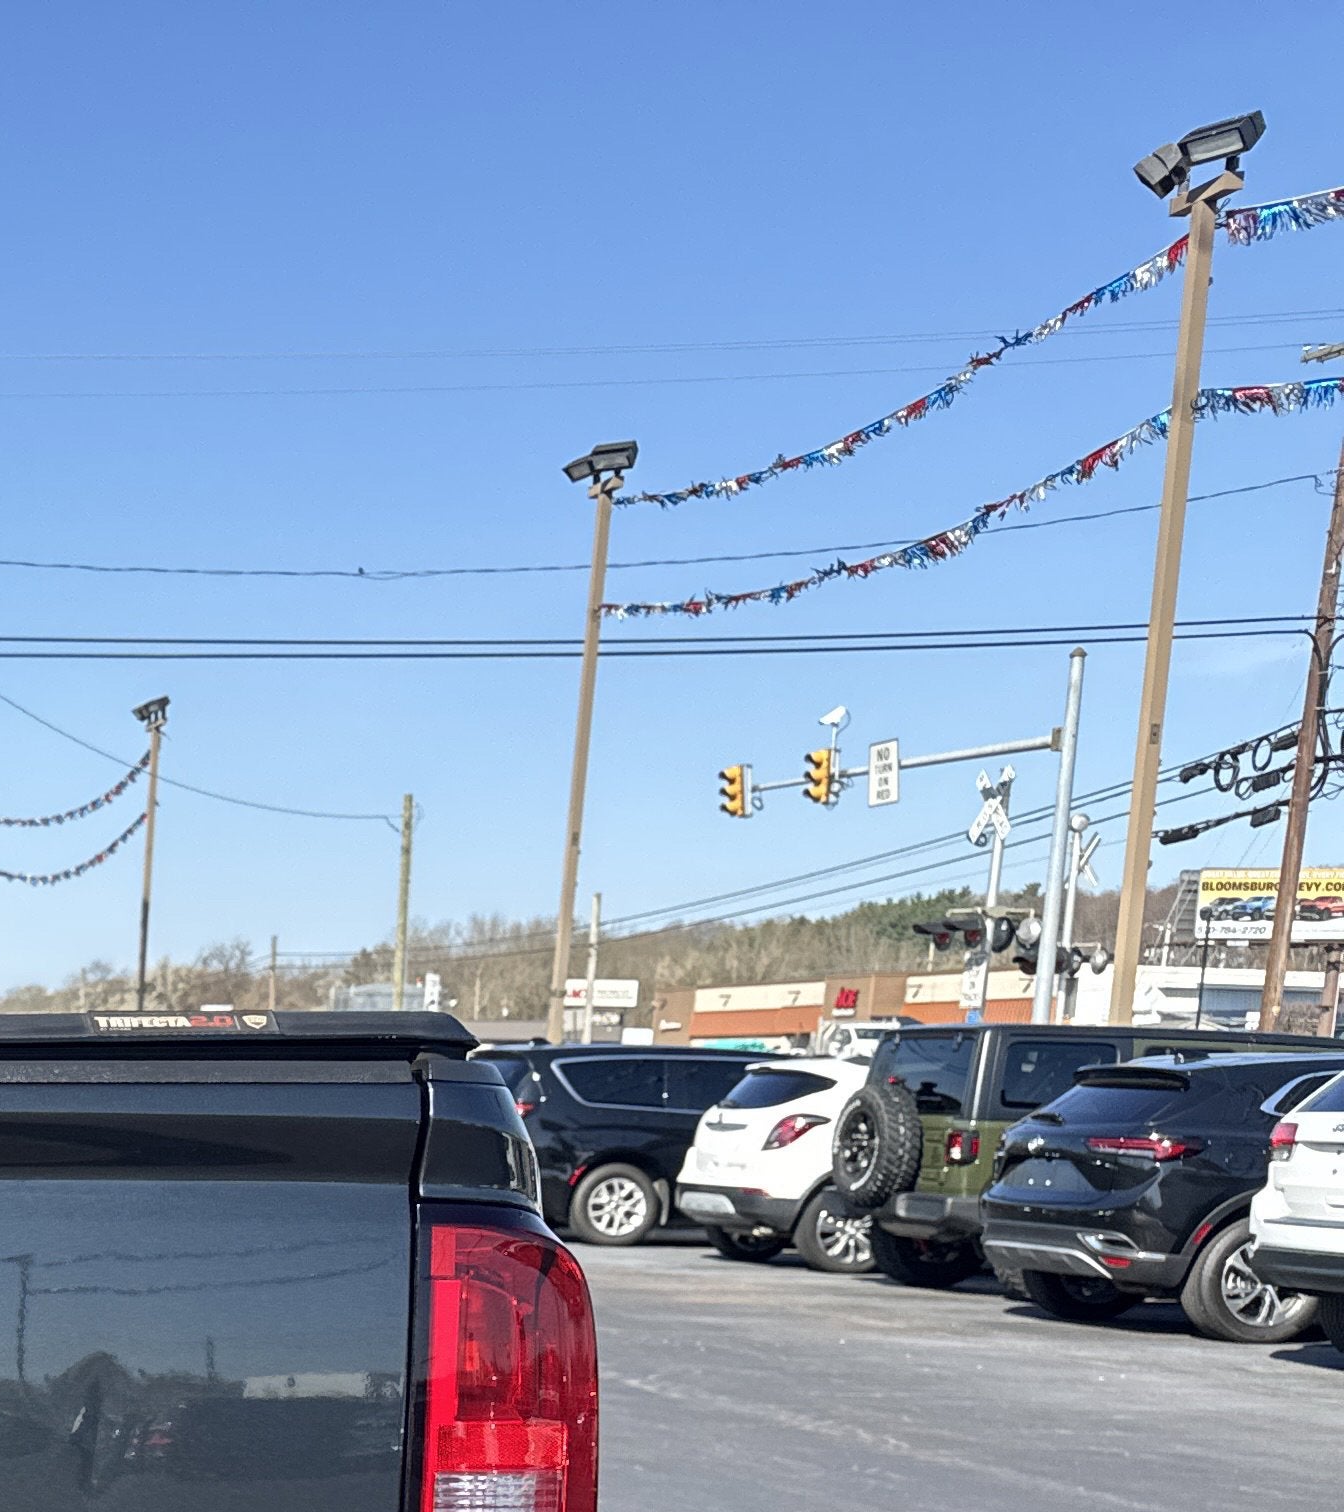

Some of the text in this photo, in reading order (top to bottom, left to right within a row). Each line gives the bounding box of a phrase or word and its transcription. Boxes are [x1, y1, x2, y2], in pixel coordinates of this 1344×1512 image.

[876, 747, 890, 762] NO
[874, 762, 892, 775] TURN
[876, 788, 891, 801] RED
[94, 1016, 192, 1027] TRIFECTA
[190, 1015, 233, 1027] 2.0
